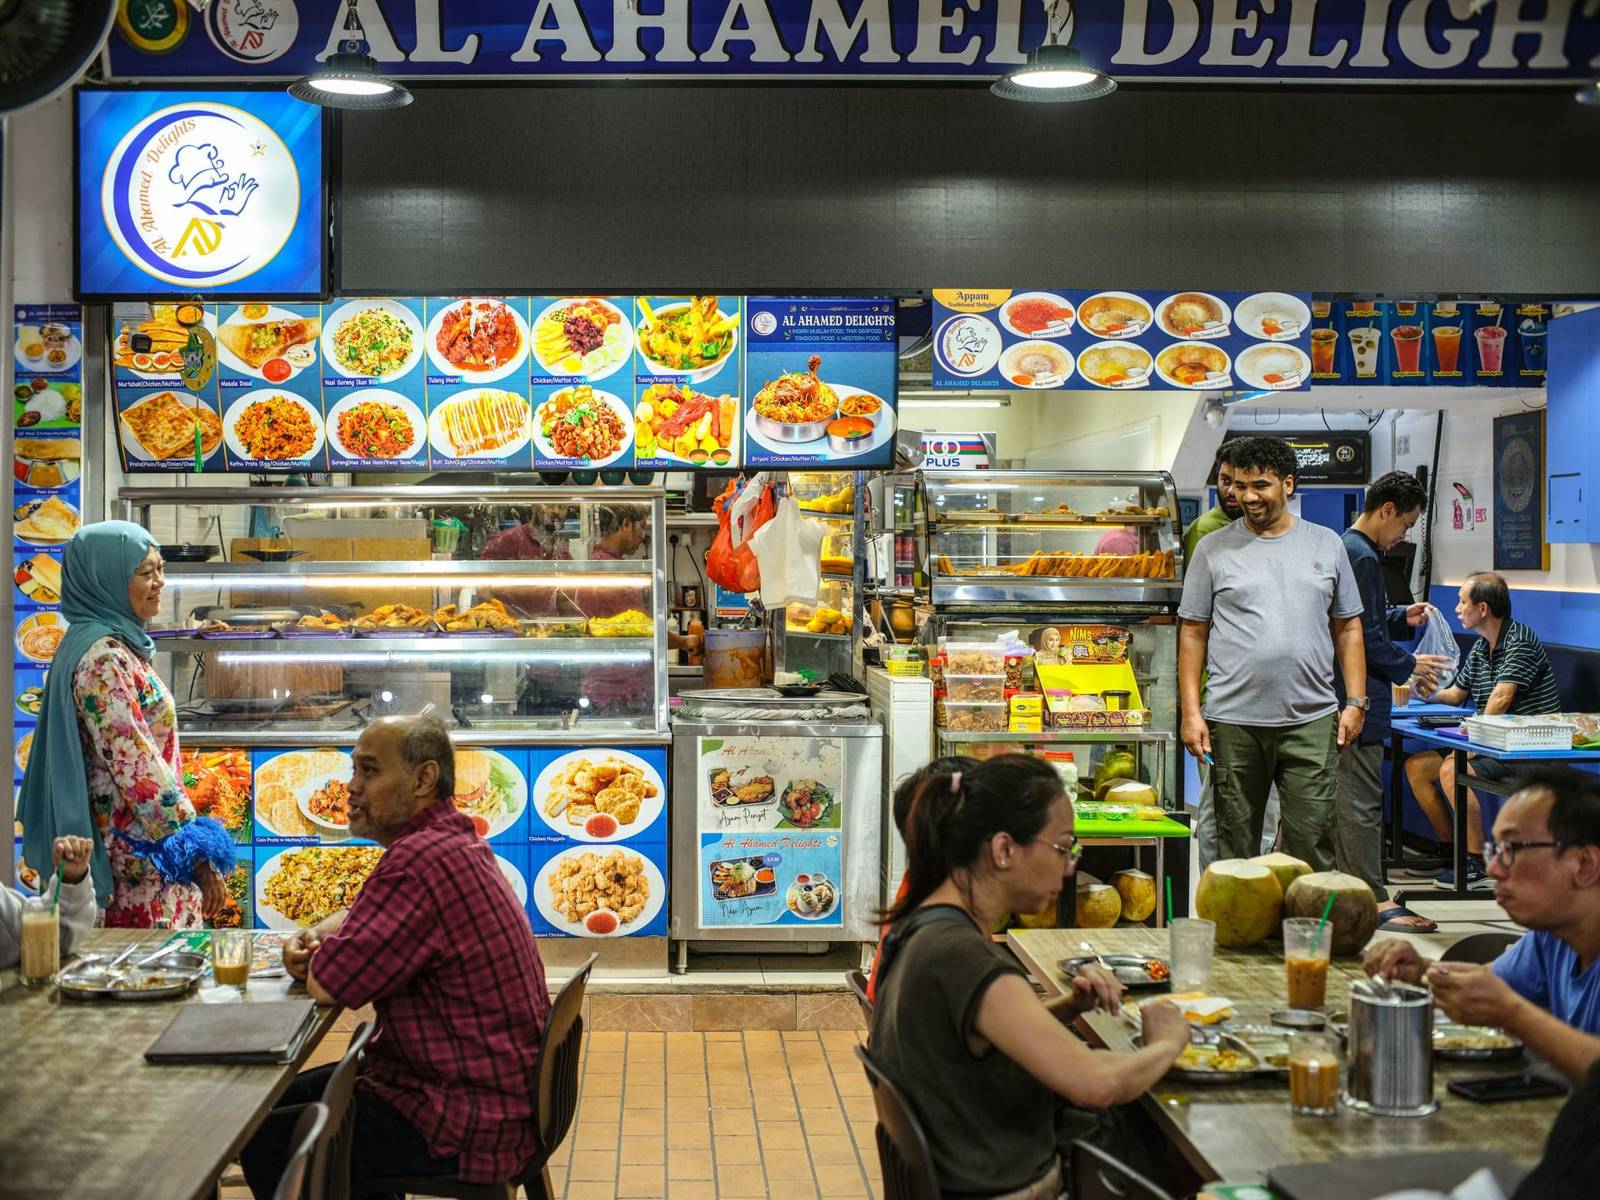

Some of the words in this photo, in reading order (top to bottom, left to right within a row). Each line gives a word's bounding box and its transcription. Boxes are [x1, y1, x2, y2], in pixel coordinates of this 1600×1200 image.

[315, 0, 479, 65] AL
[1111, 0, 1600, 70] DELIGH
[146, 118, 197, 165] Delights
[956, 291, 989, 302] Appam
[782, 315, 796, 326] AL
[798, 315, 843, 326] AHAMED
[845, 315, 895, 326] DELIGHTS
[325, 379, 336, 387] Nasi
[337, 379, 355, 388] Goreng
[356, 378, 368, 386] Ikan
[428, 377, 445, 385] Tulang
[533, 377, 572, 385] Chicken/Mutton
[573, 377, 586, 385] Chop
[923, 439, 961, 457] 100
[535, 459, 574, 467] Chicken/Mutton
[637, 459, 654, 467] Indian
[926, 457, 961, 467] PLUS
[1069, 627, 1092, 641] NIMS
[721, 837, 735, 849] Al
[738, 837, 777, 848] Ahamed
[779, 837, 822, 850] Delights
